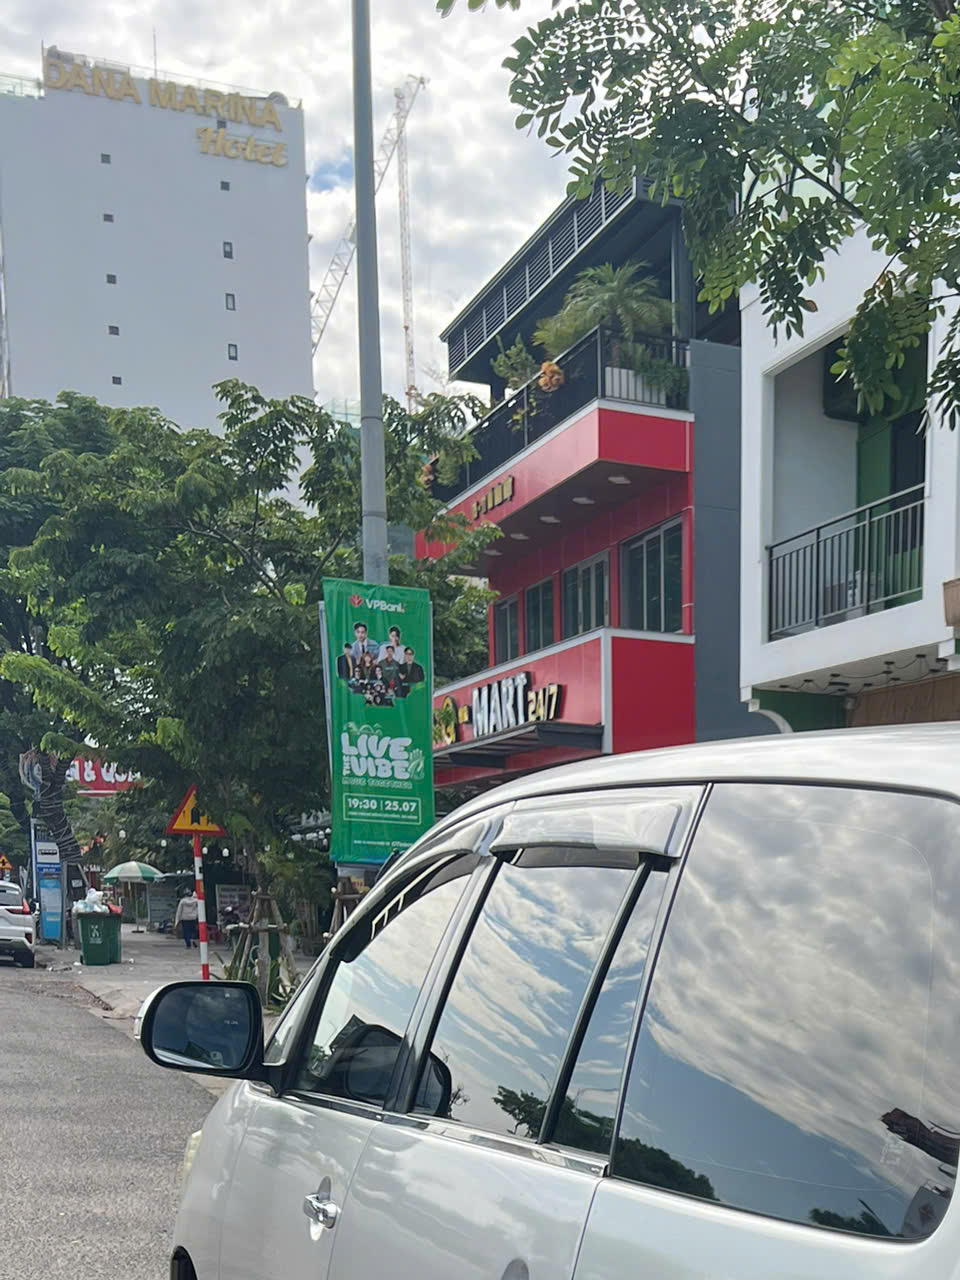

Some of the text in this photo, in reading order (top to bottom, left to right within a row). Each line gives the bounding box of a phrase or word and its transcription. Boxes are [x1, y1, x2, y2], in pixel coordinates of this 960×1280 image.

[43, 58, 283, 133] DANA MARINA
[196, 127, 289, 168] Hotel
[472, 671, 529, 738] MART
[527, 684, 561, 721] 24/7
[341, 732, 412, 759] LIVE
[347, 798, 417, 812] 19:30 25.07
